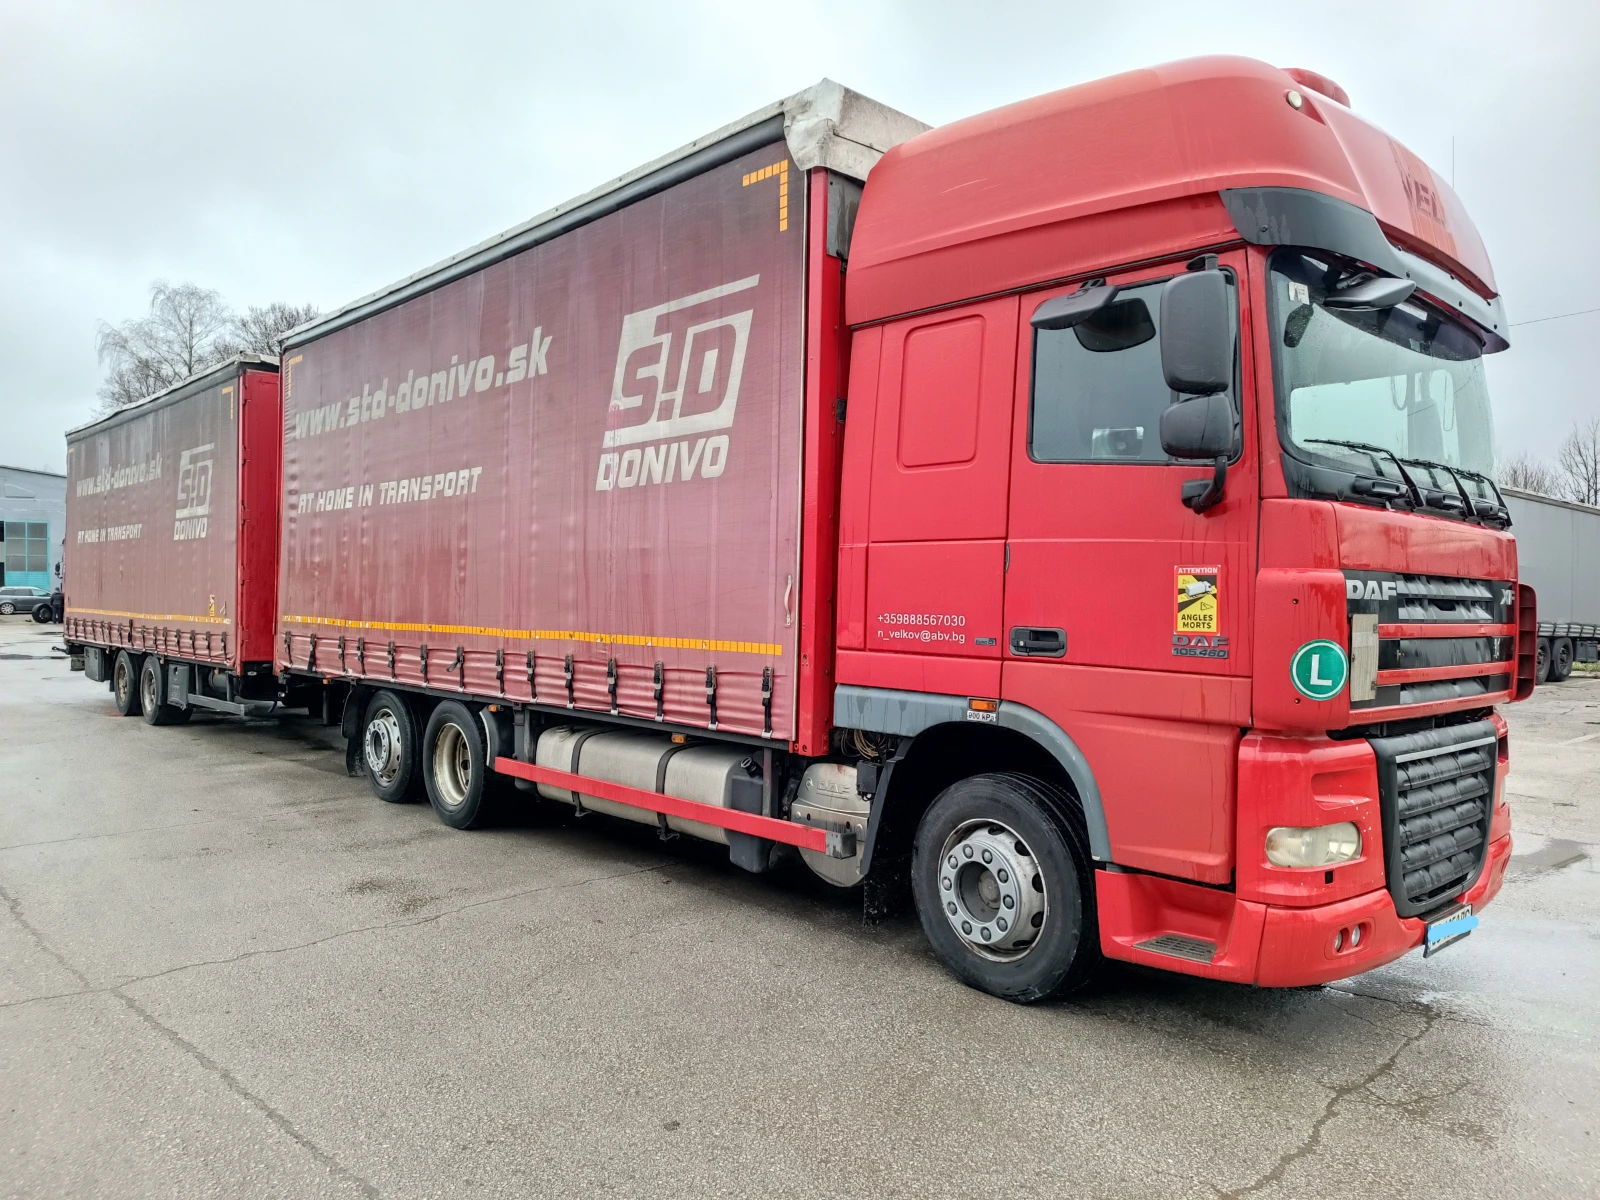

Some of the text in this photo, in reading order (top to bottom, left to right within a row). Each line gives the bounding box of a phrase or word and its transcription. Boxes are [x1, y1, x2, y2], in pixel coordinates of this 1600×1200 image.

[295, 326, 553, 439] www.std-donivo.sk
[595, 434, 730, 492] DONIVO
[298, 466, 483, 514] AT HOME IN TRANSPORT
[107, 523, 143, 541] TRANSPORT
[173, 517, 208, 541] DONIVO
[1346, 579, 1397, 601] DAF
[1500, 589, 1515, 605] XF
[877, 613, 966, 626] +359888567030
[1181, 613, 1213, 621] ANGLES
[1182, 621, 1212, 630] MORTS
[877, 629, 966, 644] n_velkov@abv.bg
[1172, 635, 1229, 647] DAF
[1173, 647, 1228, 658] 105.460
[1309, 653, 1333, 687] L
